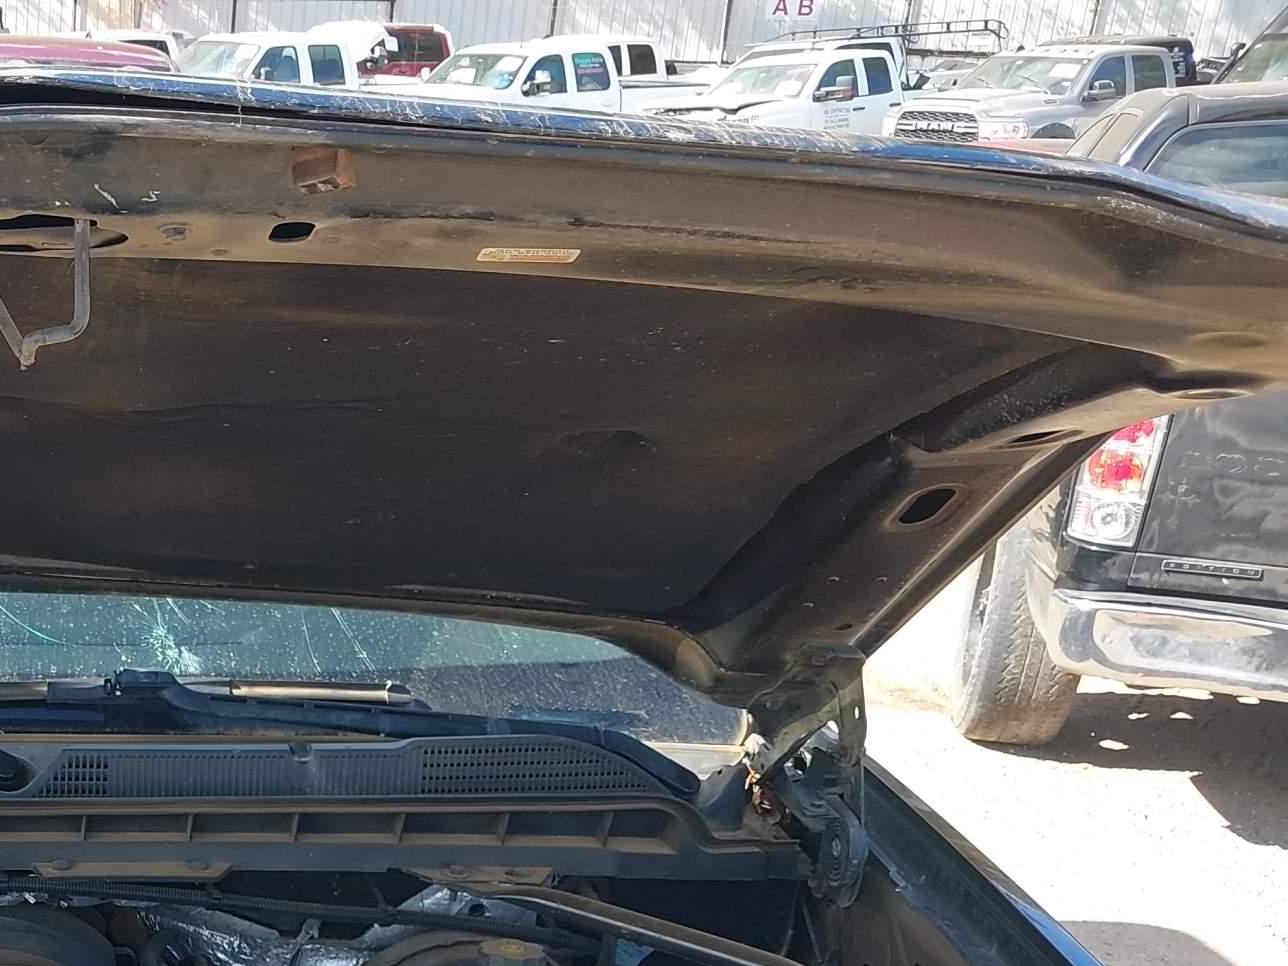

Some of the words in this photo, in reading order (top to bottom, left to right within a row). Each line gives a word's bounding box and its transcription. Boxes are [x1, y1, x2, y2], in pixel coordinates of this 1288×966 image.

[772, 0, 789, 16] A
[798, 0, 814, 16] B
[914, 121, 952, 131] RAM
